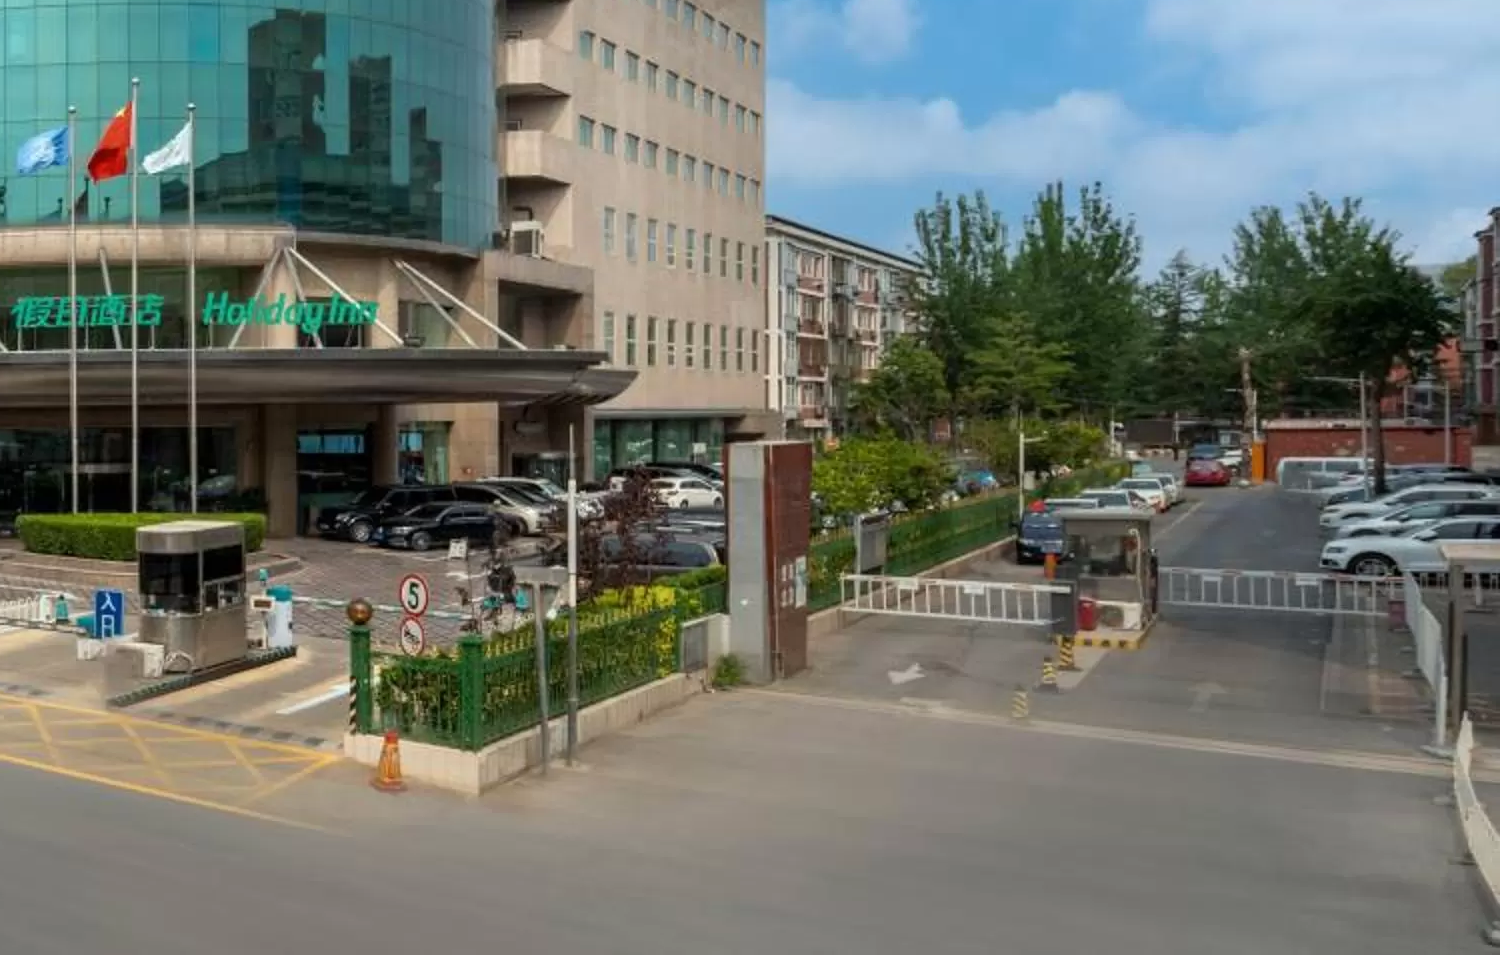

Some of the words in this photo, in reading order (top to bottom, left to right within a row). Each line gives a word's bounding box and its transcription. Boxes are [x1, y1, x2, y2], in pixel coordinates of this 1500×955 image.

[11, 293, 164, 328] 假日酒店
[202, 291, 325, 335] Holiday
[328, 292, 379, 326] Inn
[408, 580, 420, 610] 5
